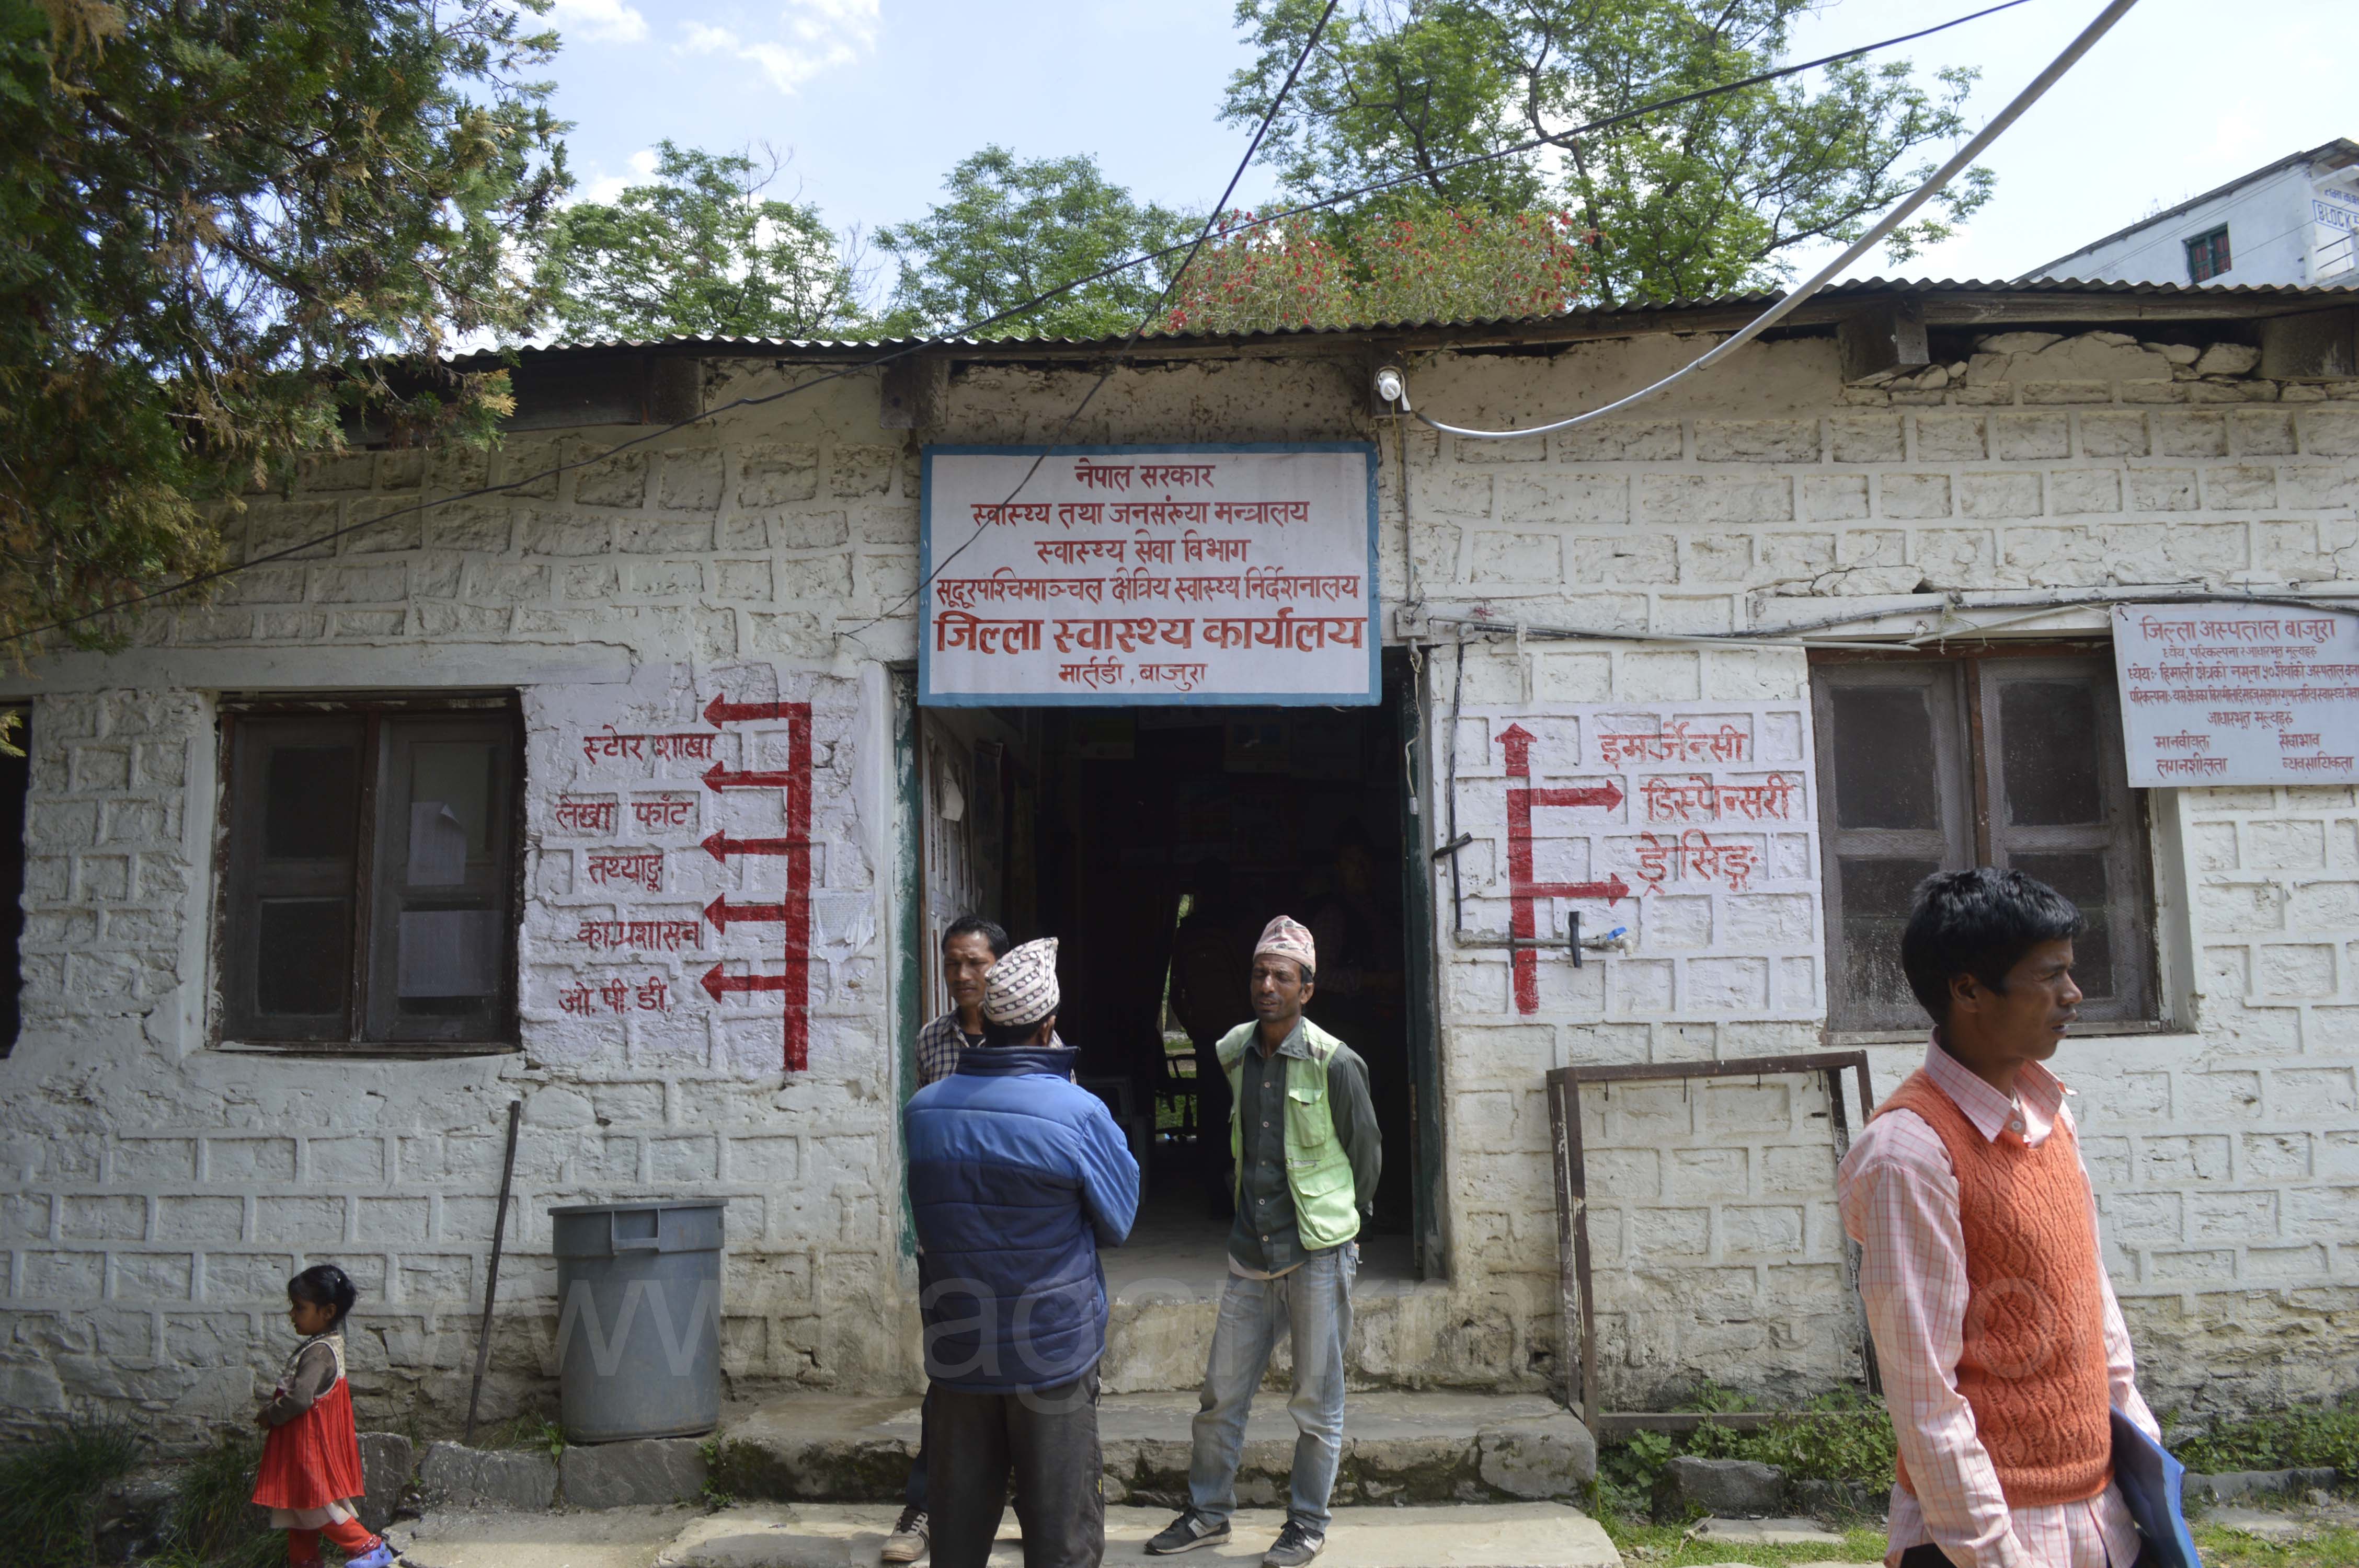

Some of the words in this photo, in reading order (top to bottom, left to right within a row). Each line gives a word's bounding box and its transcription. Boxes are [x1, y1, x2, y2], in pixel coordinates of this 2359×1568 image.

[2317, 204, 2352, 229] BLOCK
[1075, 457, 1135, 490] नेपाल
[1140, 465, 1215, 487] सरकार
[970, 503, 1052, 526] स्वास्थ्य
[1059, 502, 1104, 529] तथा
[1215, 501, 1310, 527] मन्त्रालय
[1034, 539, 1127, 564] स्वास्थ्य
[1134, 528, 1176, 564] सेवा
[1181, 529, 1251, 563] विभाग
[936, 566, 1106, 609] सूदूरपश्चिमाञ्चल
[1109, 566, 1172, 605] क्षेत्रिय
[1175, 577, 1241, 603] स्वास्थ्य
[1244, 566, 1360, 602] निर्देशनालय
[933, 610, 1045, 654] जिल्ला
[1053, 618, 1196, 653] स्वास्थ्य
[1203, 606, 1368, 652] कार्यालय
[2139, 615, 2196, 643] जिल्ला
[2200, 620, 2281, 642] अस्पताल
[2285, 618, 2336, 643] बाजुरा
[2189, 643, 2239, 659] परिकल्पना
[2247, 646, 2284, 659] आधारभूत
[1139, 663, 1208, 691] बाजुरा
[2159, 661, 2194, 686] हिमाली
[2196, 660, 2228, 683] क्षेत्रको
[2230, 665, 2260, 683] नमूना
[2306, 664, 2344, 681] अस्पताल
[2208, 711, 2251, 729] आधारभूत
[583, 724, 647, 766] स्टोर
[654, 734, 716, 762] शाखा
[1597, 721, 1749, 770] इमर्जेन्सी
[2153, 729, 2211, 752] मानवीयता
[2278, 729, 2321, 750] सेवाभाव
[2156, 752, 2228, 778] लगनशीलता
[2282, 751, 2355, 774] व्यवसायिकता
[1639, 773, 1795, 821] डिस्पेन्सरी
[555, 795, 615, 830] लेखा
[631, 793, 694, 827] फाँट
[588, 854, 663, 892] तथ्याङ्क
